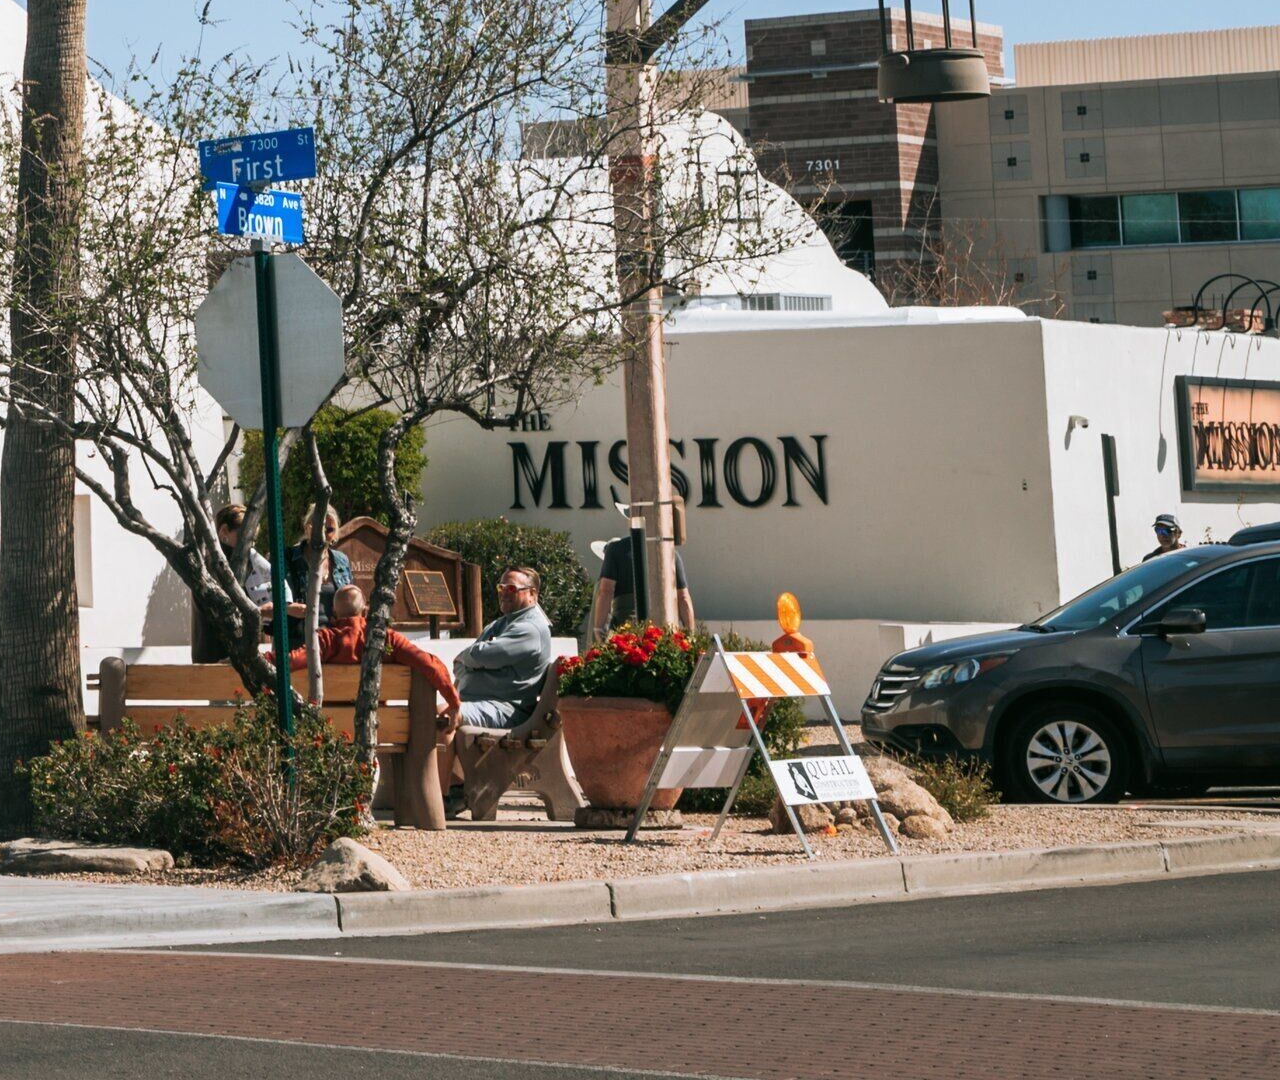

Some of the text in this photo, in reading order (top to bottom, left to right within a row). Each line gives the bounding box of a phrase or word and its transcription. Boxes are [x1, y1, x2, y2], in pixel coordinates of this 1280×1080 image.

[204, 134, 308, 157] E 7300 St
[231, 154, 283, 182] First
[805, 159, 840, 171] 7301
[219, 188, 226, 200] N
[282, 197, 299, 210] Ave
[238, 207, 283, 237] Brown
[806, 760, 854, 779] QUAIL
